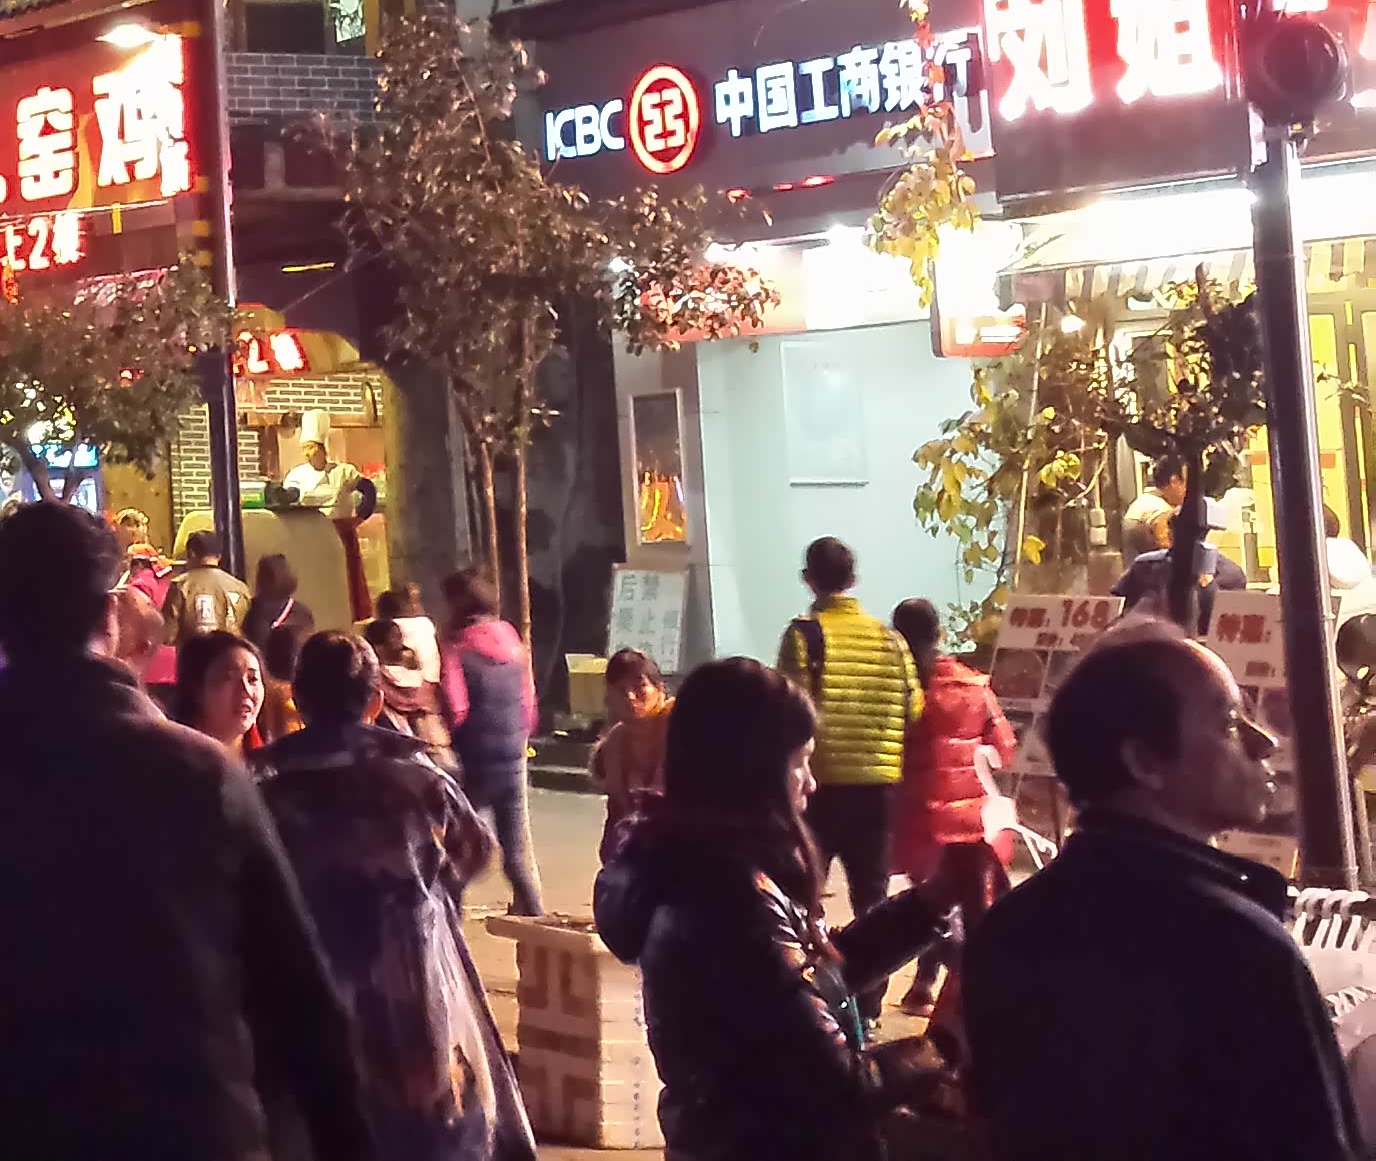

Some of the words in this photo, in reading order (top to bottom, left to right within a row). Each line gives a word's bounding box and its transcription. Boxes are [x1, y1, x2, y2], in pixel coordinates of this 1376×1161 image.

[714, 38, 973, 138] 中国工商银行
[545, 98, 625, 162] ICBC
